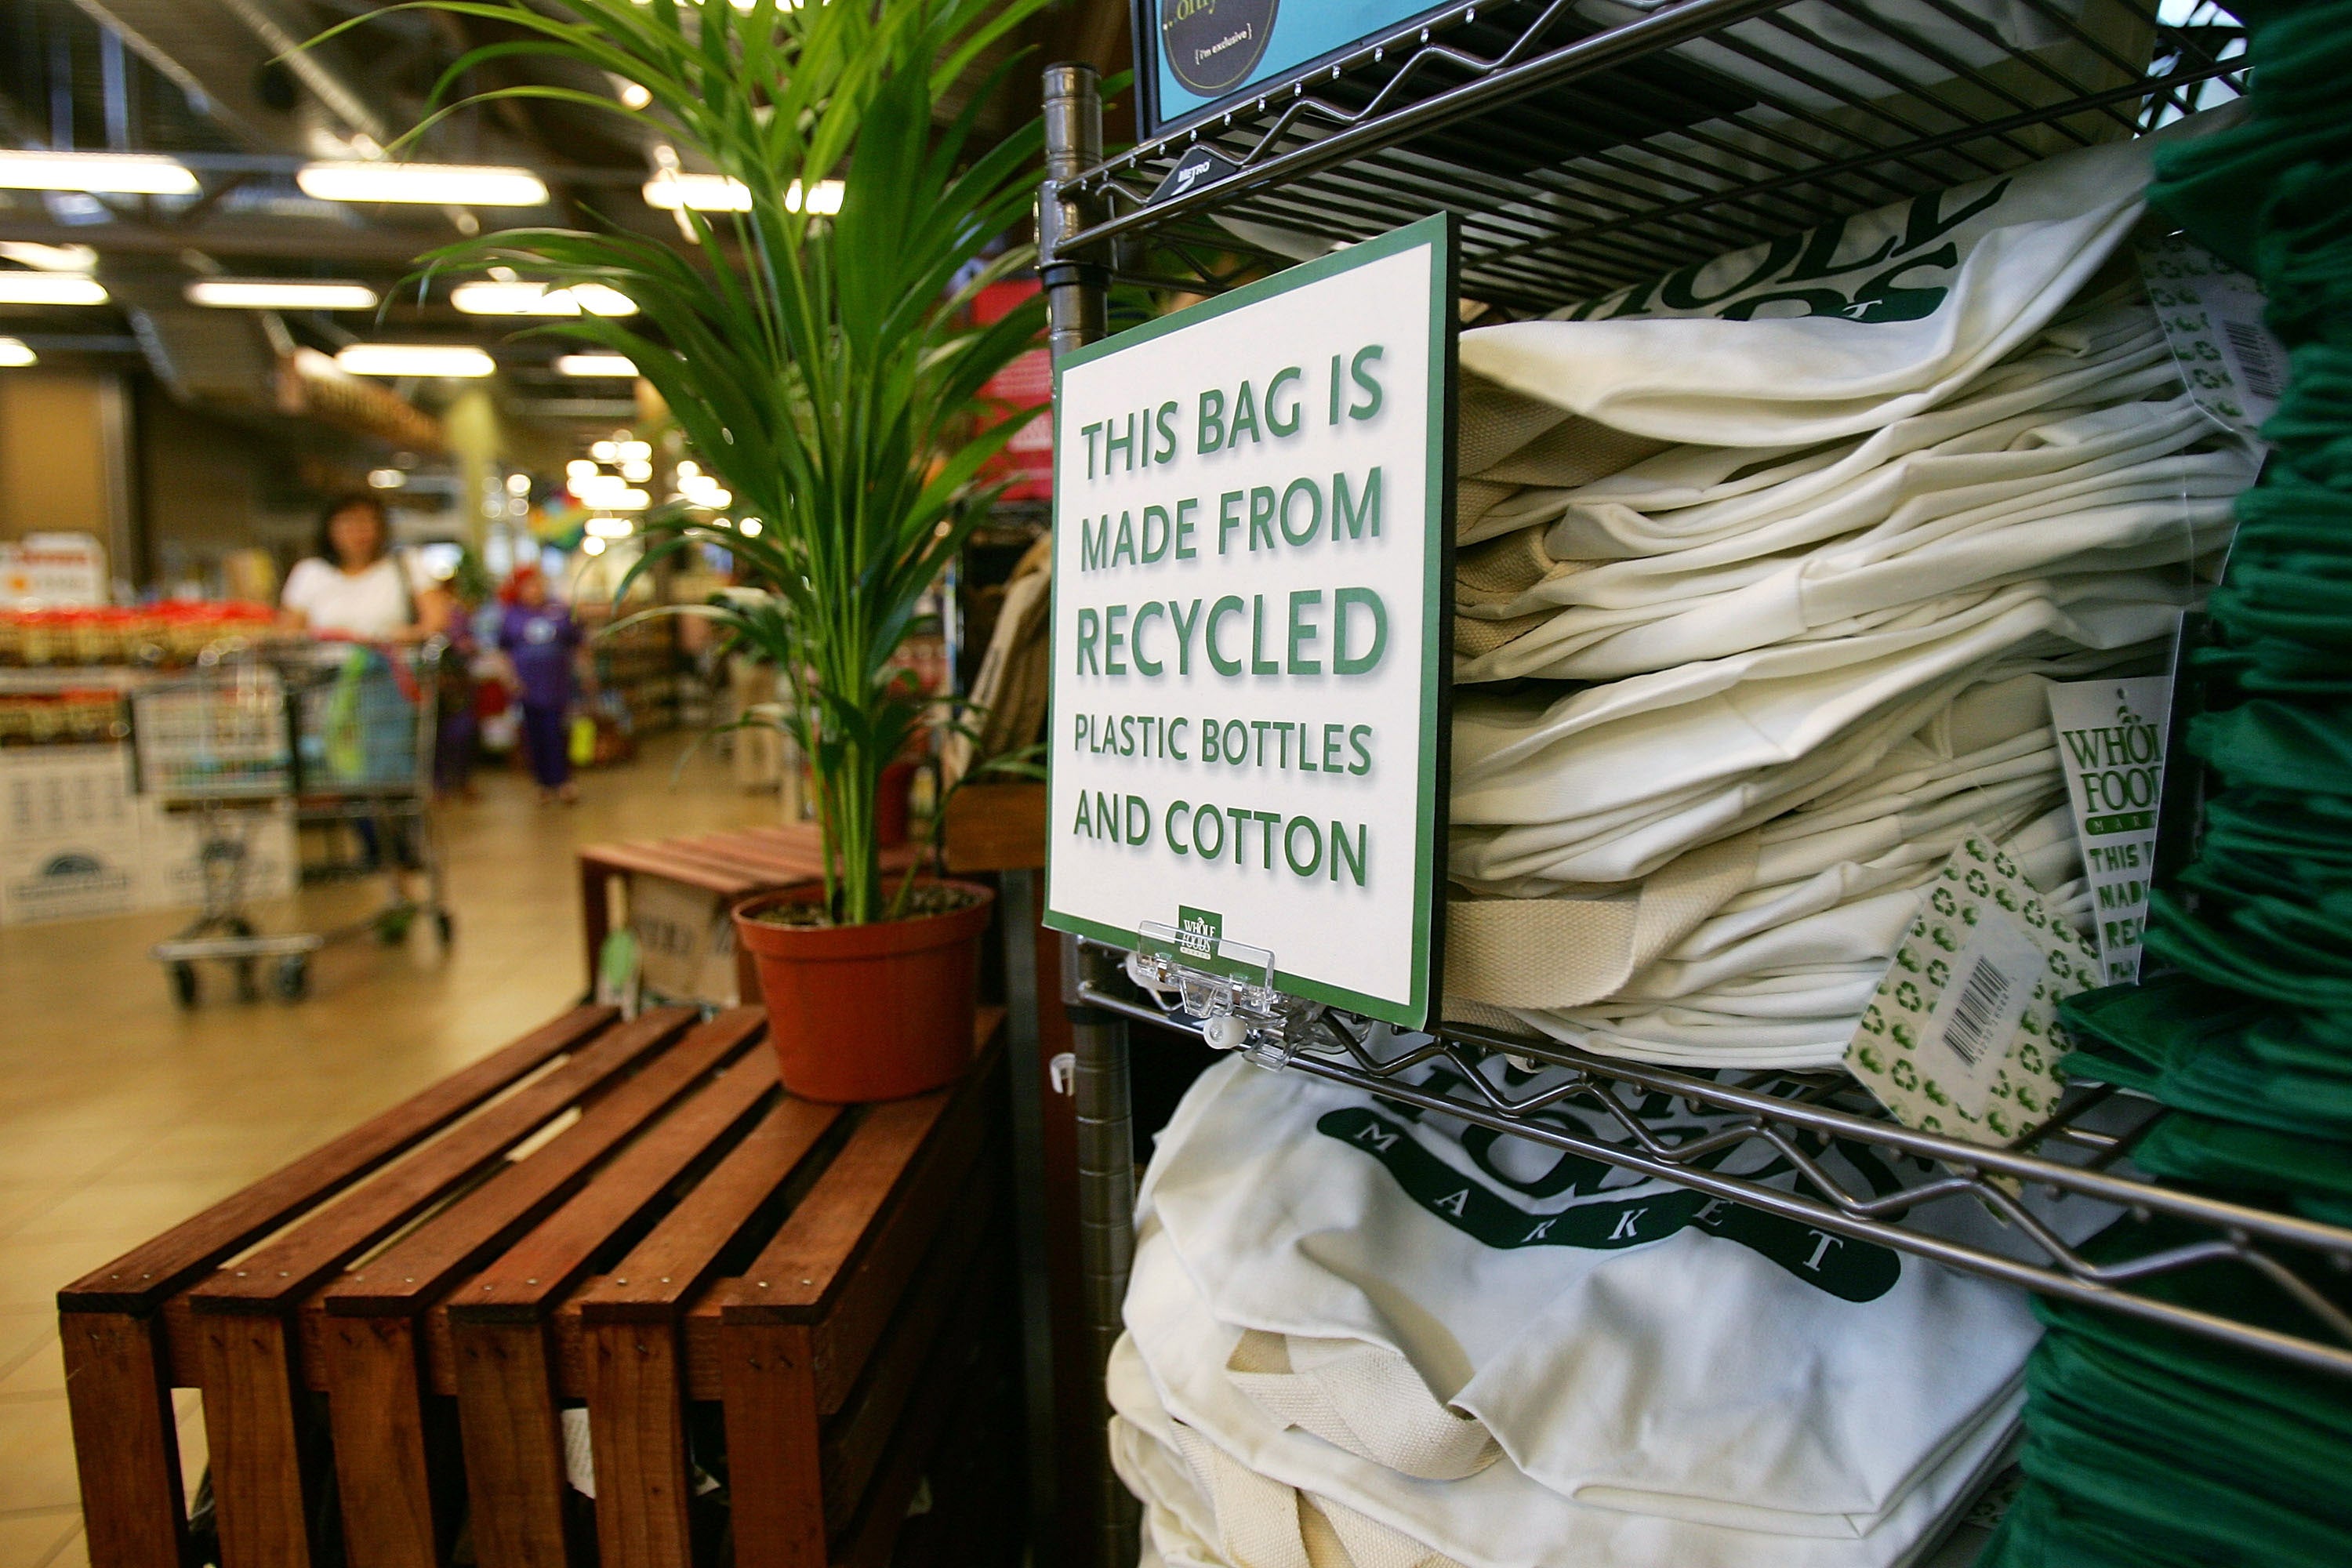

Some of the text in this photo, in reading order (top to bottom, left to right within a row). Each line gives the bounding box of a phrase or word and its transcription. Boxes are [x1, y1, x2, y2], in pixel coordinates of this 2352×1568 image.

[1174, 161, 1210, 192] METRO
[1080, 344, 1385, 481] THIS BAG IS
[1081, 466, 1381, 572] MADE FROM
[1076, 586, 1388, 677] RECYCLED
[1074, 713, 1373, 776] PLASTIC BOTTLES
[1073, 789, 1367, 887] AND COTTON
[2089, 844, 2140, 873] THIS
